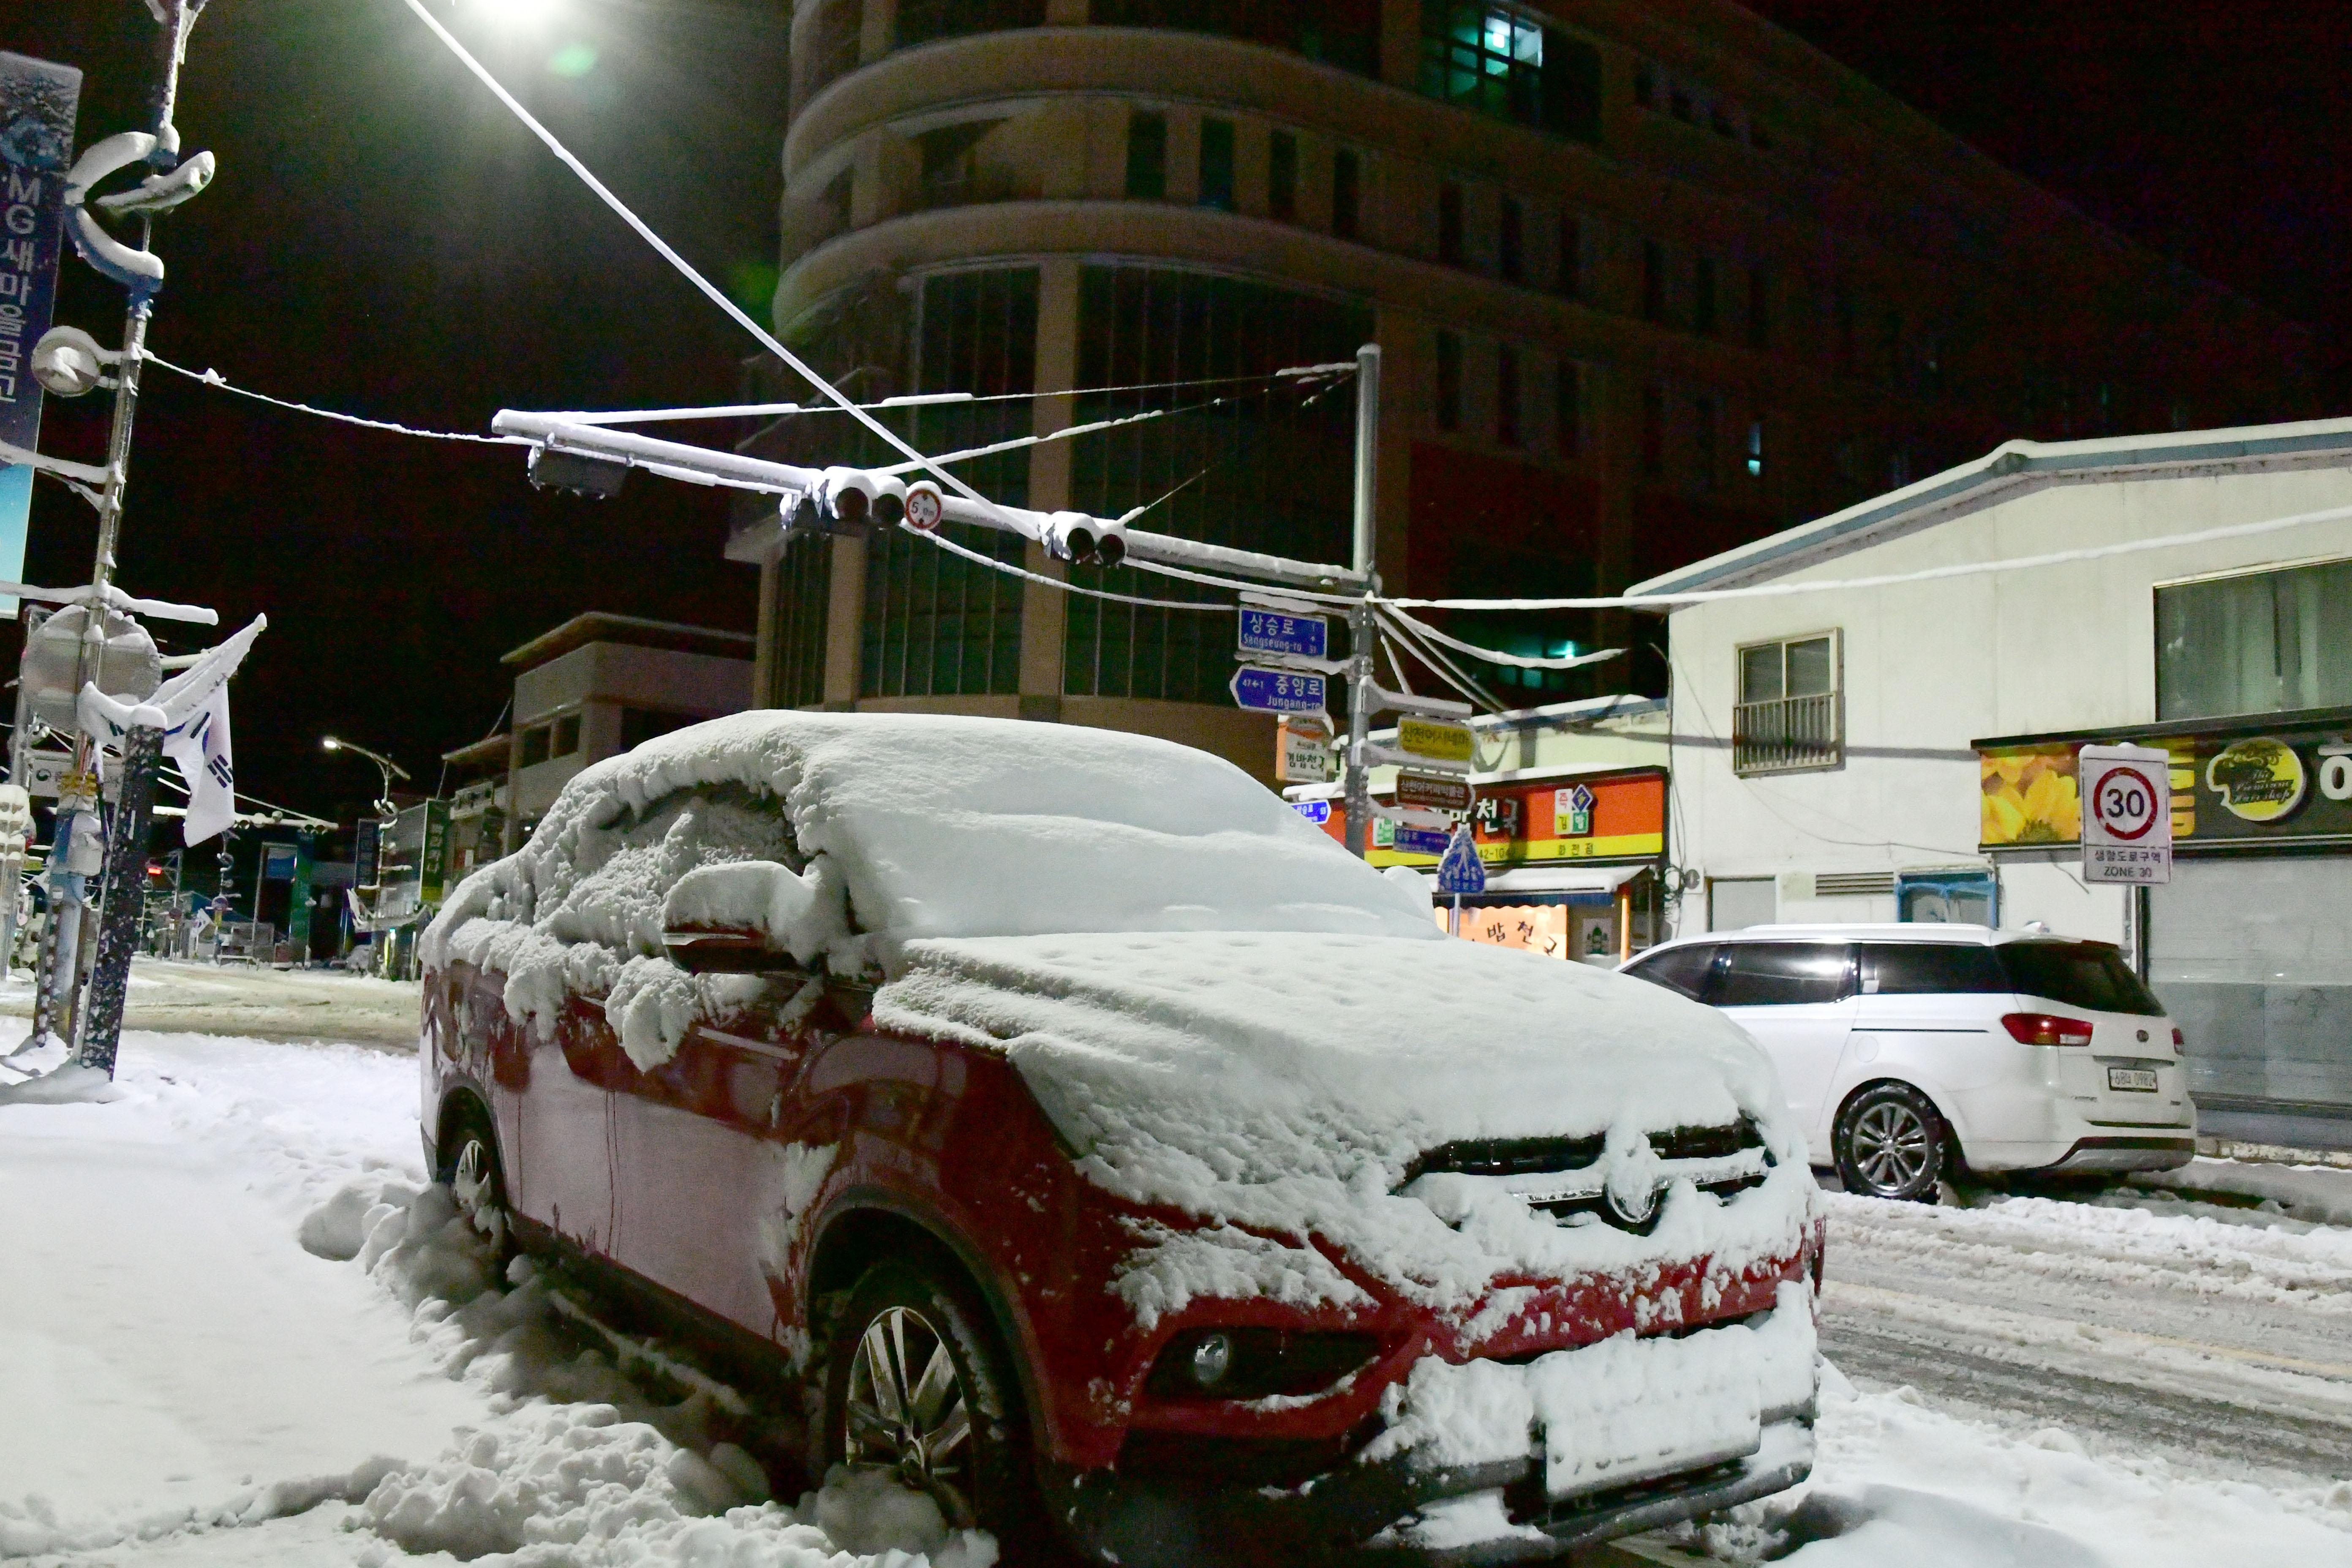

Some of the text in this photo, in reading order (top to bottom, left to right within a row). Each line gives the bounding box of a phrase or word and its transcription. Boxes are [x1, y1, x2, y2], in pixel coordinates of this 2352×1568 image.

[1250, 614, 1294, 635] 상승로
[1276, 676, 1321, 697] 중앙로
[1267, 696, 1320, 710] Jungang-ro
[1287, 752, 1325, 772] 김밥천국
[2106, 788, 2145, 818] 30
[1429, 798, 1518, 836] 밥천국
[2095, 849, 2161, 864] 생활도로구역
[2104, 866, 2152, 878] ZONE 30
